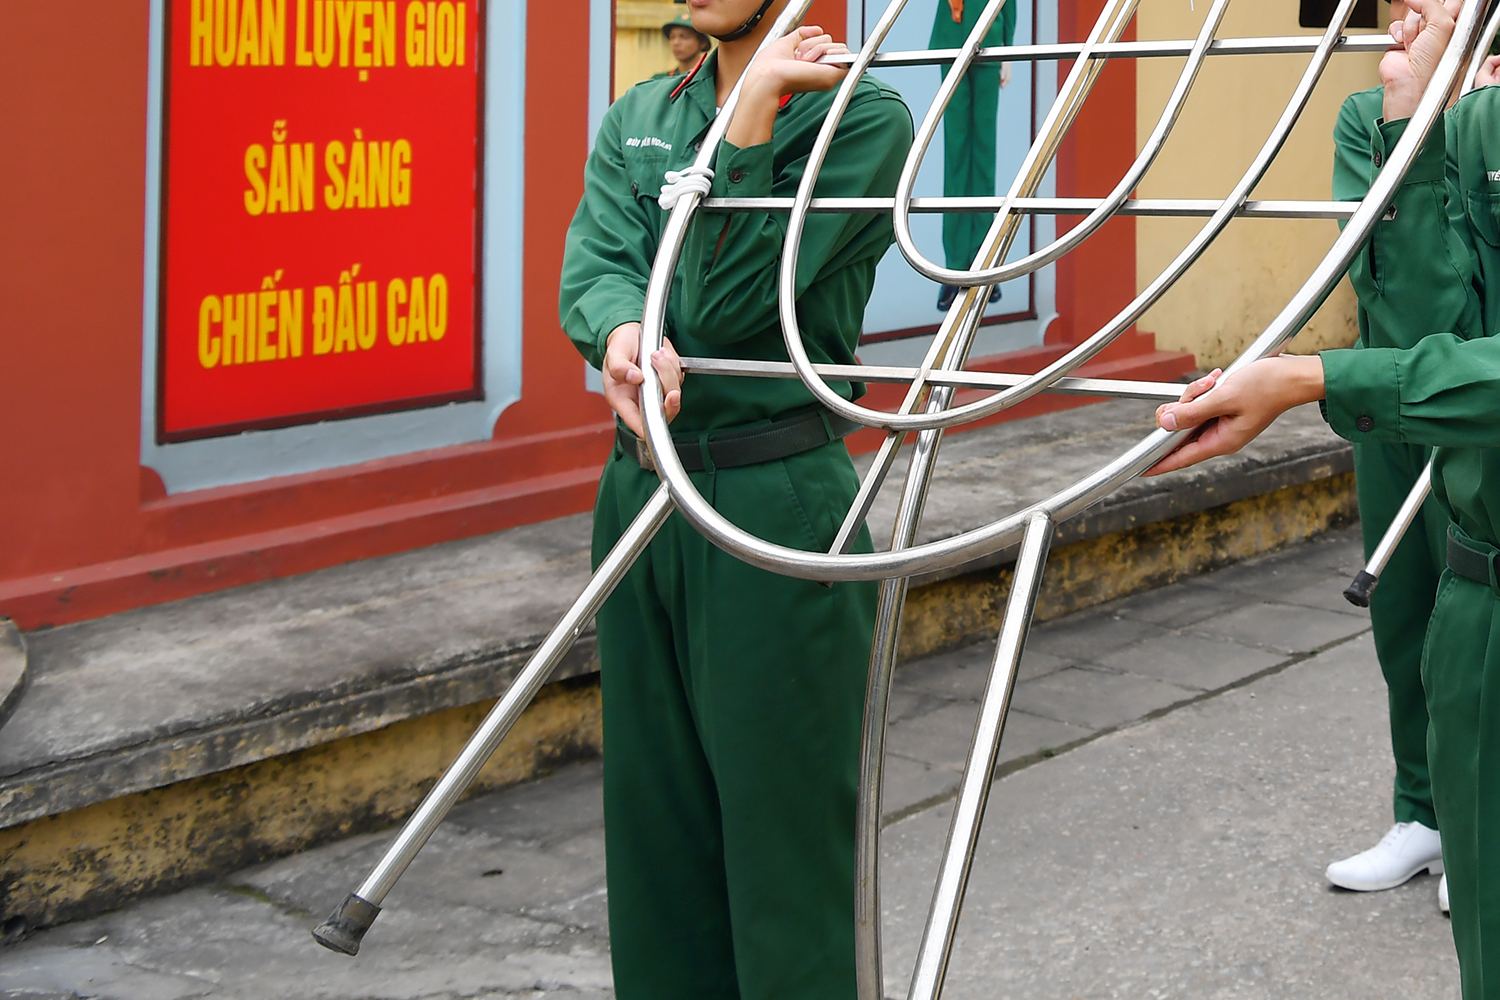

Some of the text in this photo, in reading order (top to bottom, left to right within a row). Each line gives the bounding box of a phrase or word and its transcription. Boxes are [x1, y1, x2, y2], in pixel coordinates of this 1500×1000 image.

[325, 128, 411, 210] SÀNG
[199, 264, 448, 368] CHIẾN ĐẤU CAO
